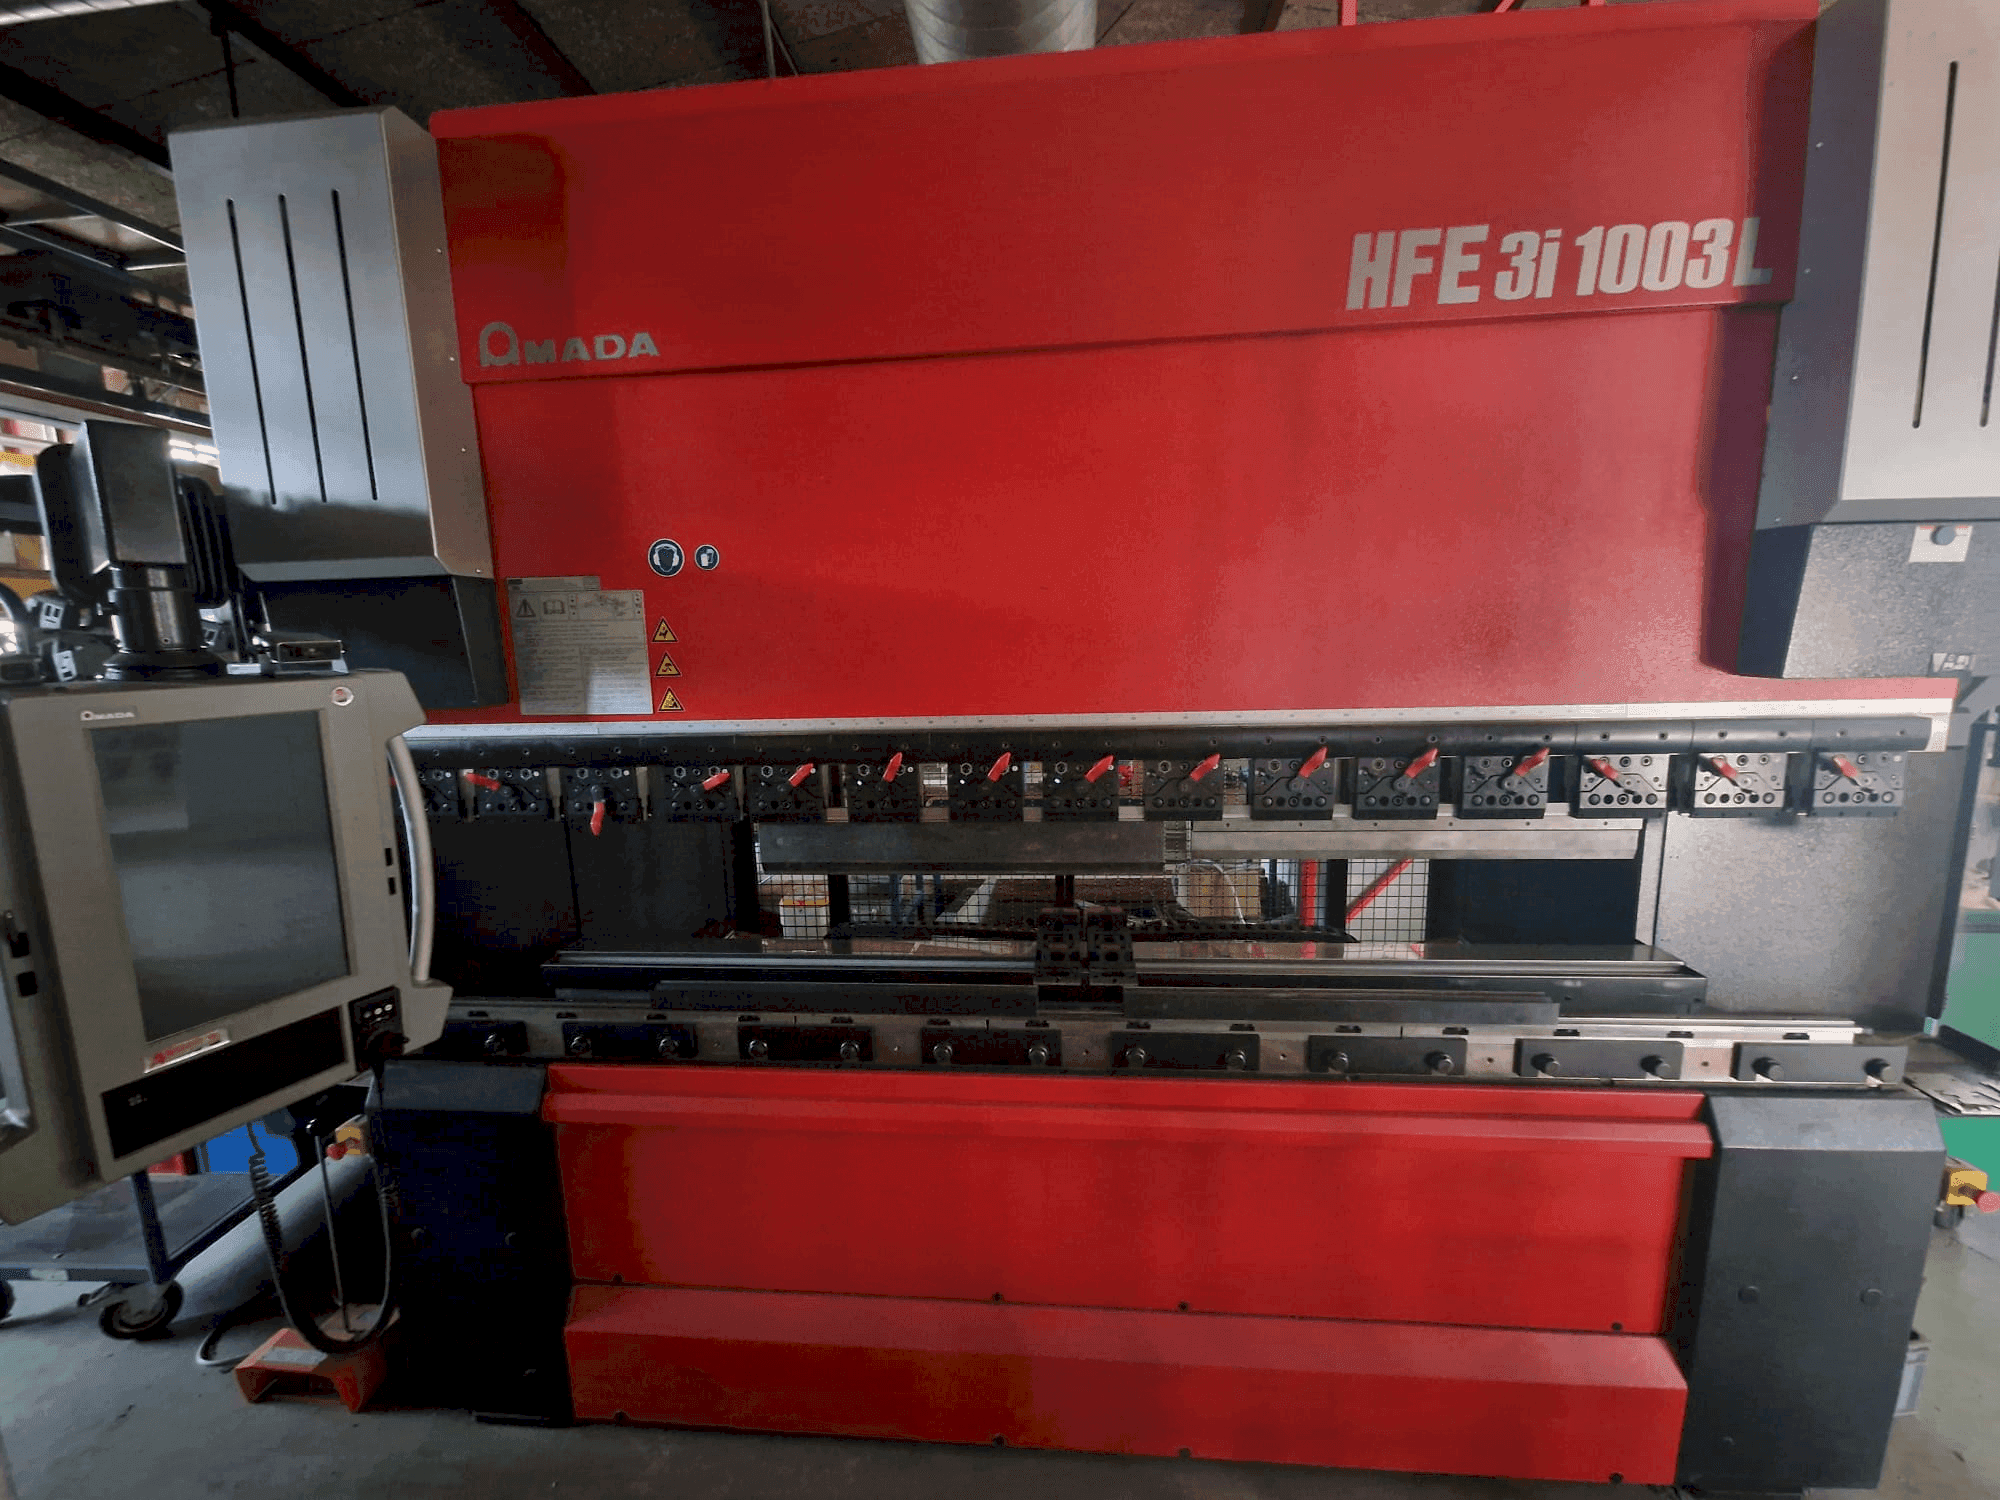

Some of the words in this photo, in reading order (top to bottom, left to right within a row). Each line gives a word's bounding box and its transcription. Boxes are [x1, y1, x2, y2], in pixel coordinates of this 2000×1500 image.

[1346, 224, 1489, 310] HFE
[1494, 229, 1562, 300] 3i
[1576, 217, 1773, 296] 1003L
[480, 322, 660, 367] AMADA
